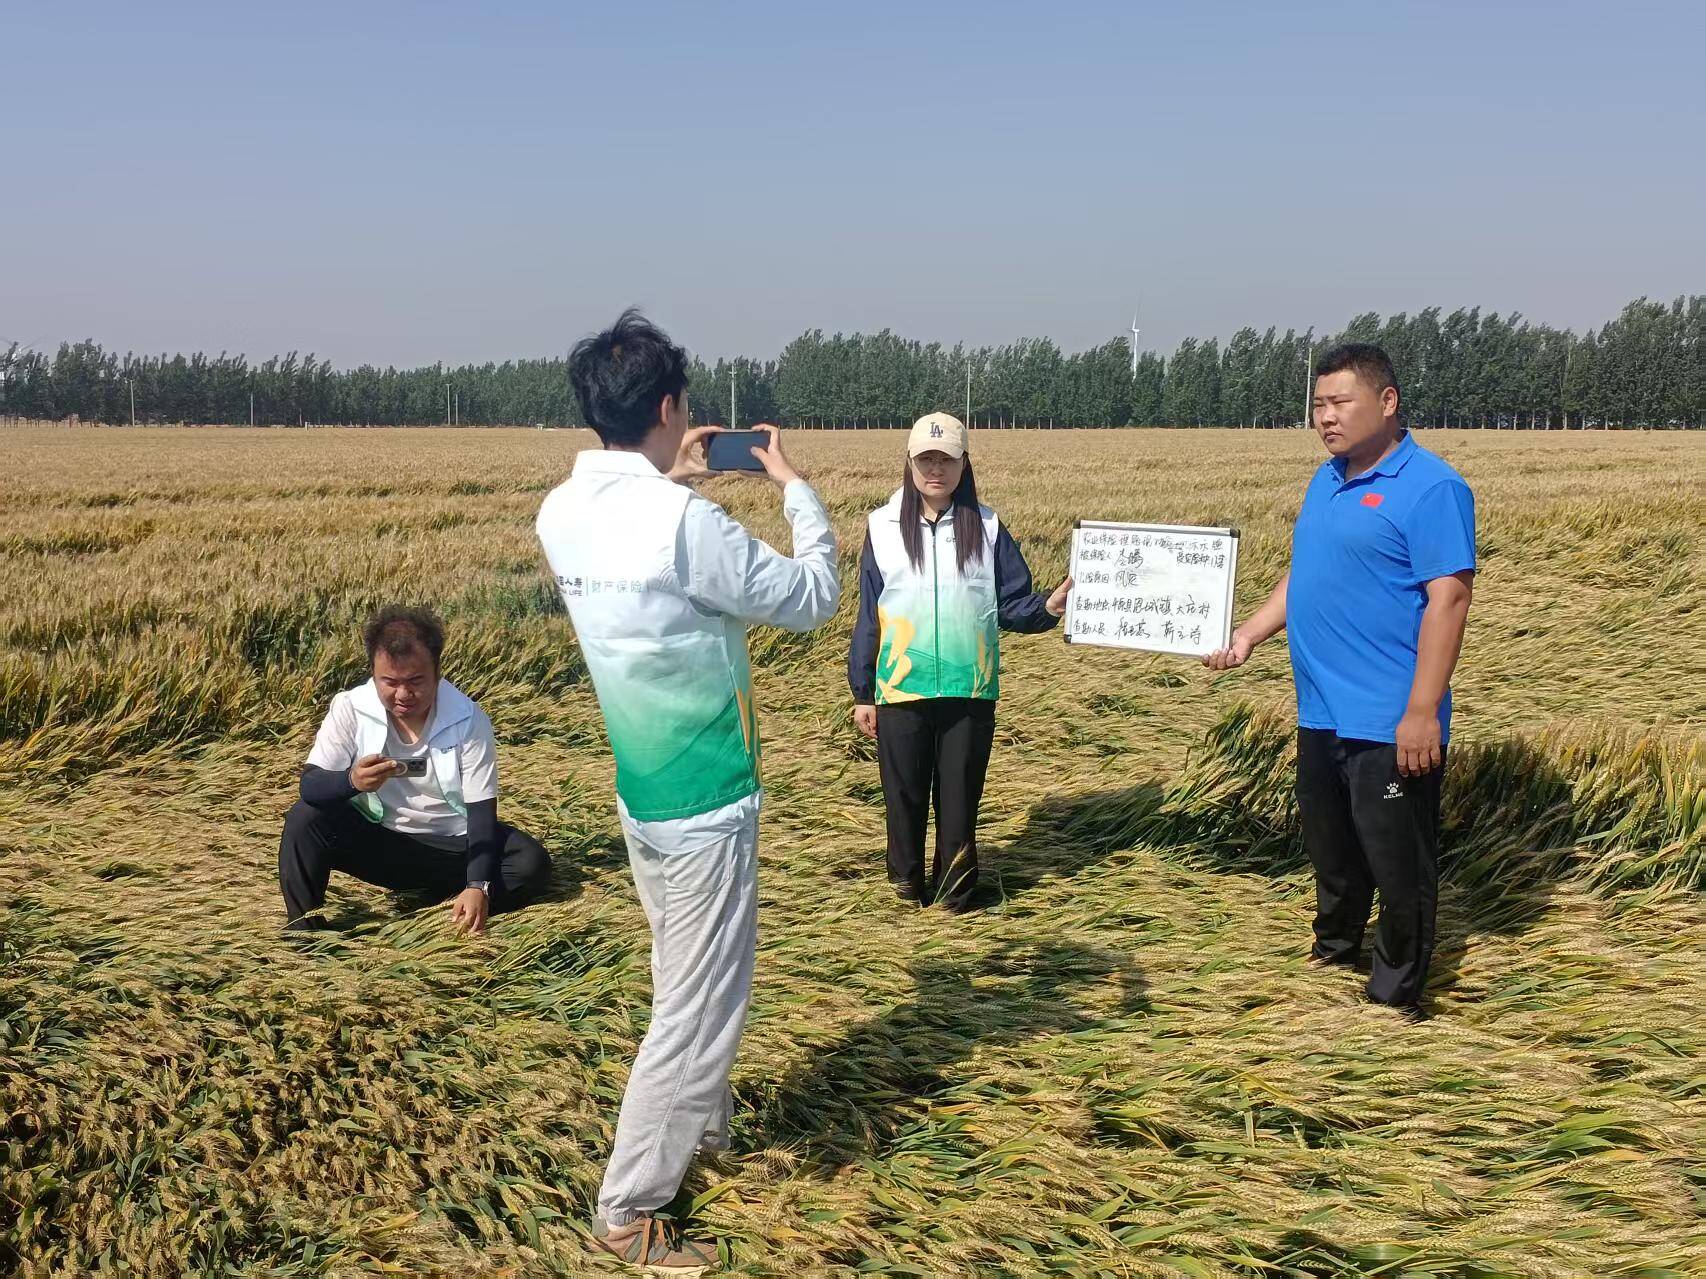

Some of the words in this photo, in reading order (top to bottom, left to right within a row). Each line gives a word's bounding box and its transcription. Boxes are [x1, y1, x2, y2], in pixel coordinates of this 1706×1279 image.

[930, 421, 943, 438] LA
[1079, 548, 1112, 561] 被保险人
[591, 579, 642, 594] 财产保险
